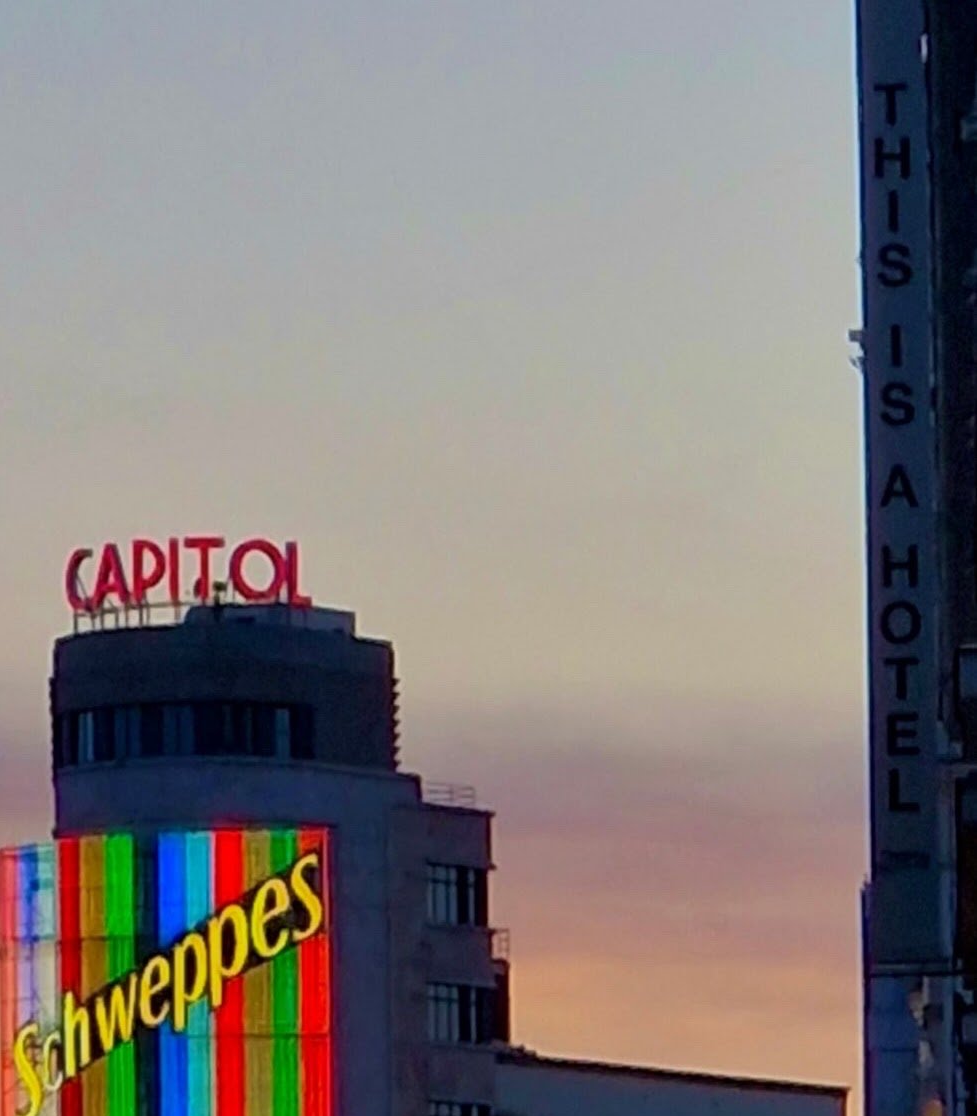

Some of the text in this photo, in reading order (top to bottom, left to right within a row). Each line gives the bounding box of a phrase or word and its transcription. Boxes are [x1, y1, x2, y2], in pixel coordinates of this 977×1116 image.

[66, 537, 313, 613] CAPITOL
[874, 82, 922, 812] THIS IS A HOTEL
